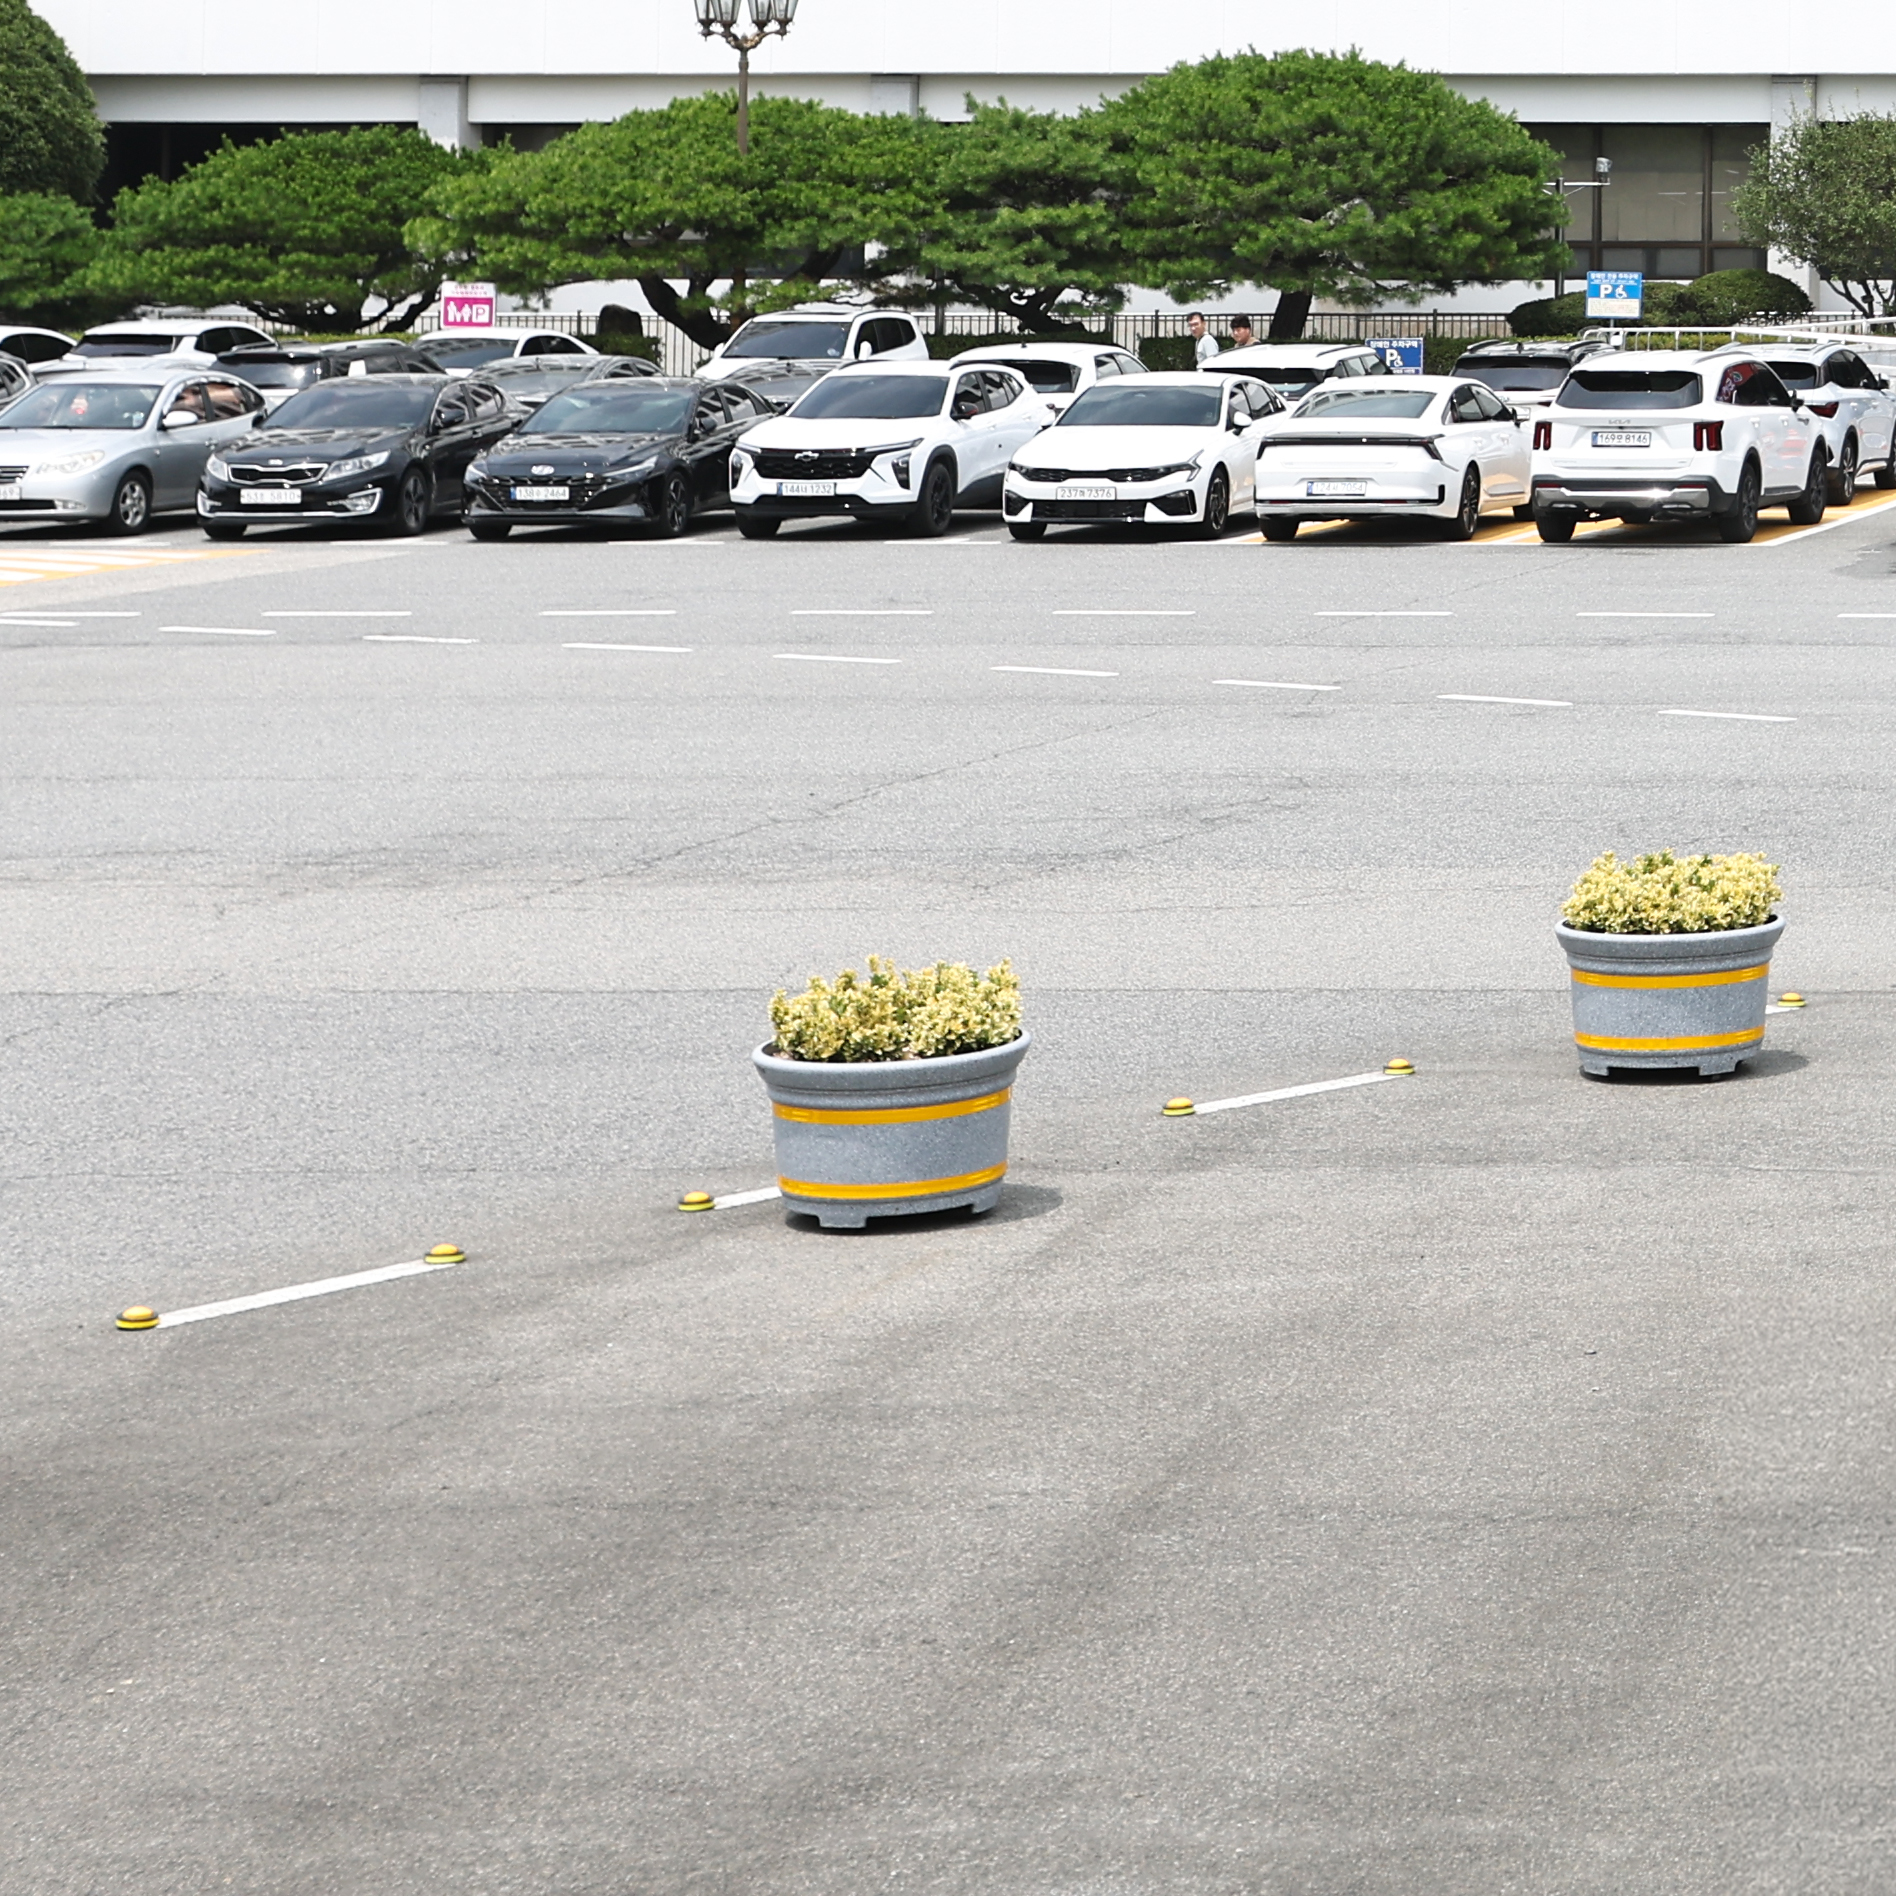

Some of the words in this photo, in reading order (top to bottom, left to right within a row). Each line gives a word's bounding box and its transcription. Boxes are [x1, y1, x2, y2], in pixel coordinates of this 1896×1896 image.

[1600, 284, 1612, 299] P
[475, 306, 486, 321] P
[1370, 340, 1390, 349] 장애인
[1391, 340, 1418, 349] 주차구역
[1385, 348, 1399, 367] P
[1624, 434, 1648, 444] 8146
[544, 488, 566, 498] 2464
[810, 484, 832, 494] 1232
[1087, 489, 1112, 498] 7376
